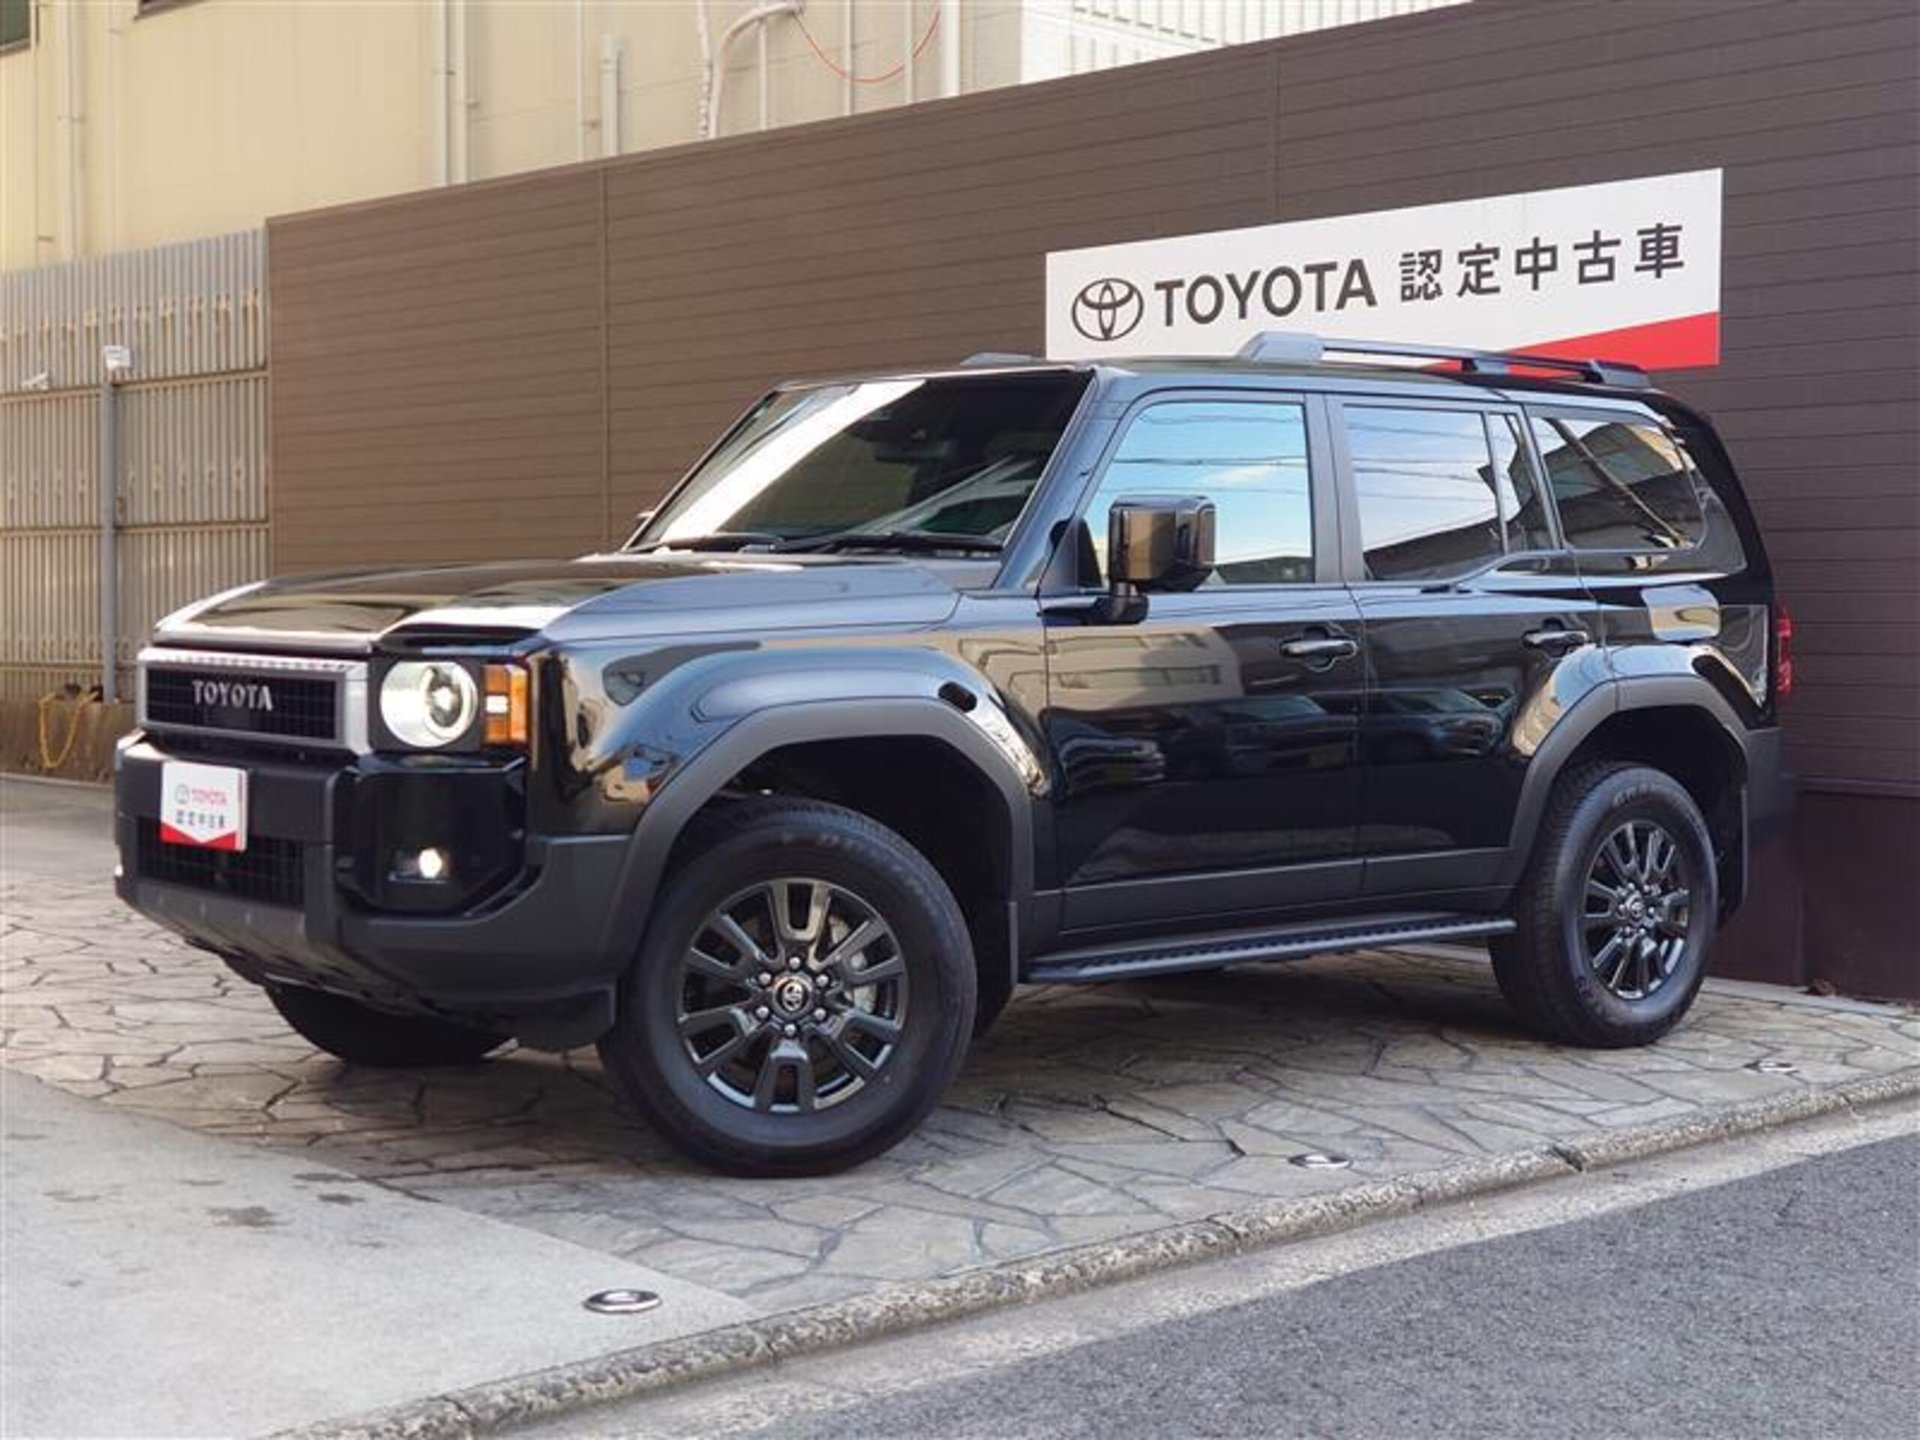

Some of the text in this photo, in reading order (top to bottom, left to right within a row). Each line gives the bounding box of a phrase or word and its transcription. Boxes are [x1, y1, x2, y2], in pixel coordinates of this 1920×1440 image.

[1154, 222, 1686, 328] TOYOTA 認定中古車
[191, 679, 274, 711] TOYOTA
